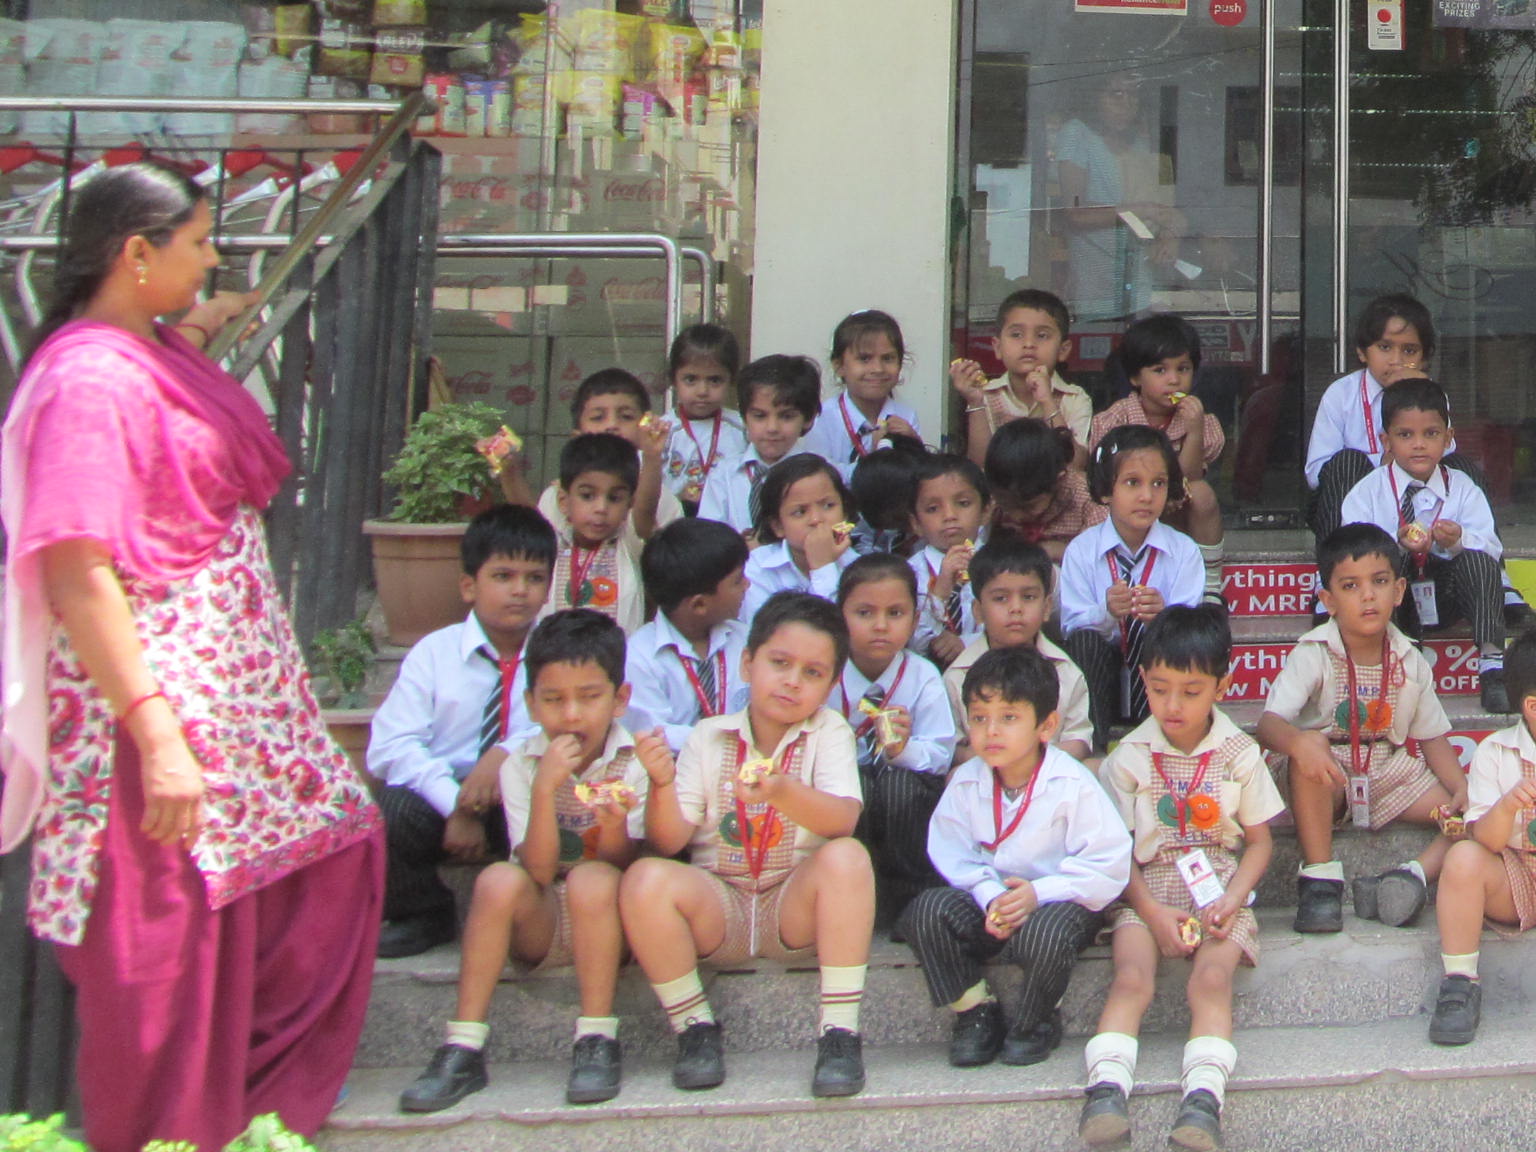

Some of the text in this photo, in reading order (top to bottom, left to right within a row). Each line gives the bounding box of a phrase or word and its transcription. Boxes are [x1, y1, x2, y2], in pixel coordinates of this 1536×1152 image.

[1214, 2, 1242, 15] push
[1439, 1, 1481, 10] EXCITING
[1444, 9, 1476, 18] PRIZES
